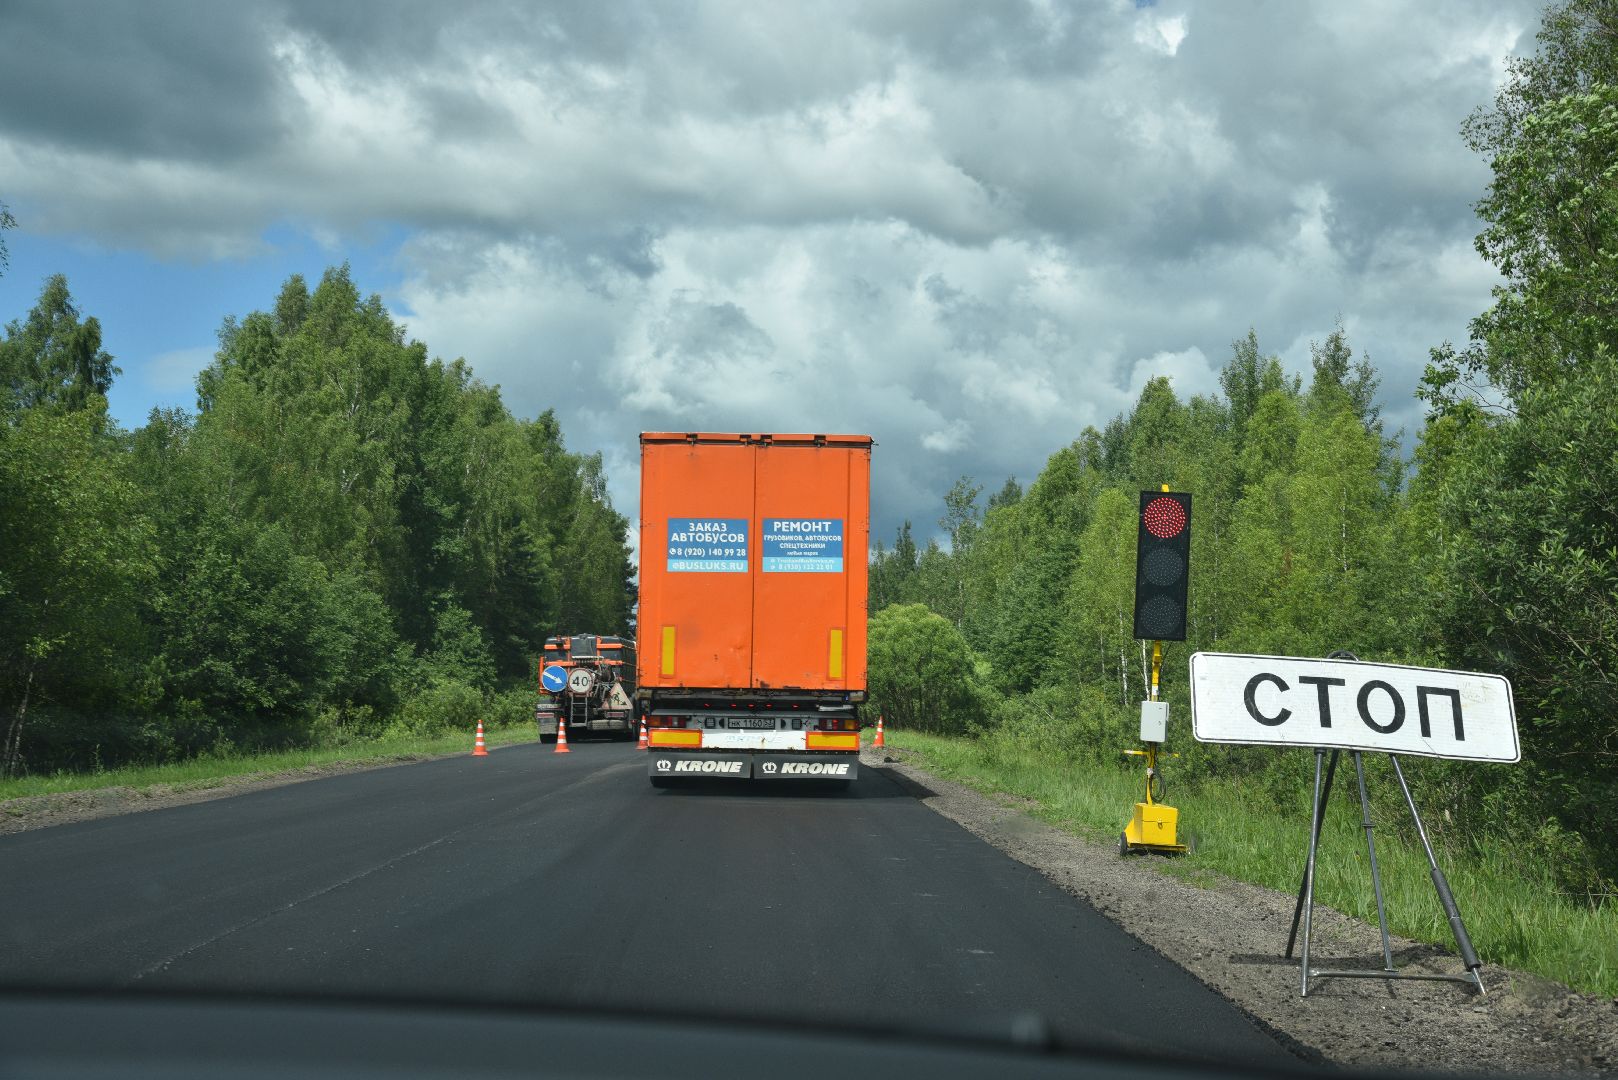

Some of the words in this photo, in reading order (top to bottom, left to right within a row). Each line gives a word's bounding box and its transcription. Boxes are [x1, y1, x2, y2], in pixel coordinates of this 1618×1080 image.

[689, 522, 727, 532] ЗАКАЗ
[773, 521, 832, 532] РЕМОНТ
[671, 533, 745, 544] АВТОБУСОВ
[677, 548, 682, 556] 8
[684, 547, 706, 558] (920)
[709, 548, 723, 556] 140
[724, 548, 735, 557] 99
[736, 548, 747, 557] 28
[572, 676, 588, 687] 40
[1243, 672, 1465, 741] СТОП
[675, 760, 743, 773] KRONE
[781, 762, 850, 775] KRONE
